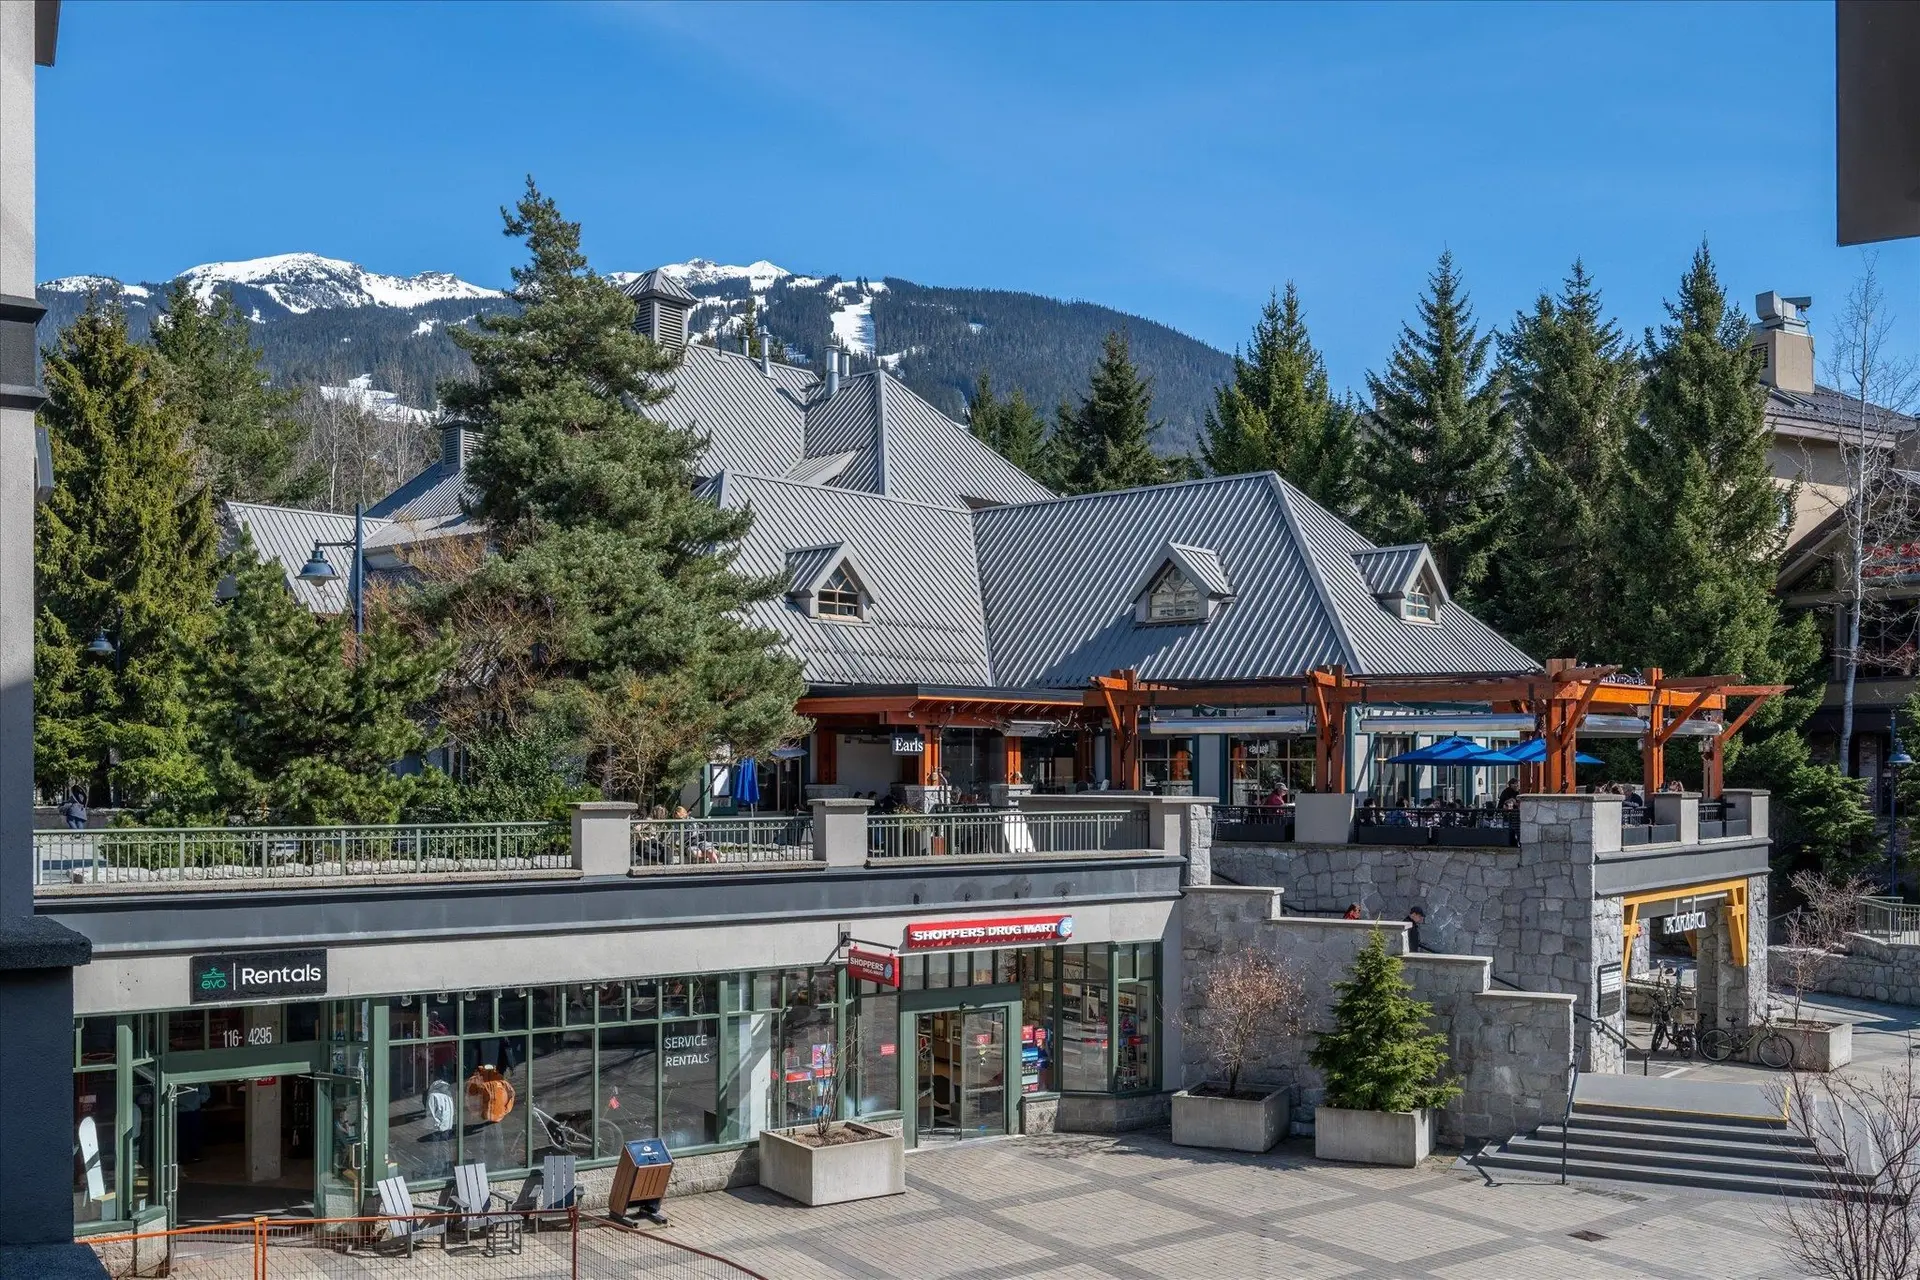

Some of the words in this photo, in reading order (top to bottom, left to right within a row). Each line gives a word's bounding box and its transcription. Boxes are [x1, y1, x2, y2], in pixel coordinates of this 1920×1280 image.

[895, 737, 924, 752] Earls
[912, 926, 985, 941] SHOPPERS
[988, 926, 1022, 937] DRUG
[1024, 923, 1057, 934] MART
[850, 957, 884, 971] SHOPPERS
[201, 979, 227, 990] evo
[242, 964, 321, 985] Rentals
[223, 1029, 243, 1048] 116-
[248, 1026, 273, 1045] 4295
[664, 1034, 708, 1049] SERVICE
[665, 1053, 710, 1067] RENTALS
